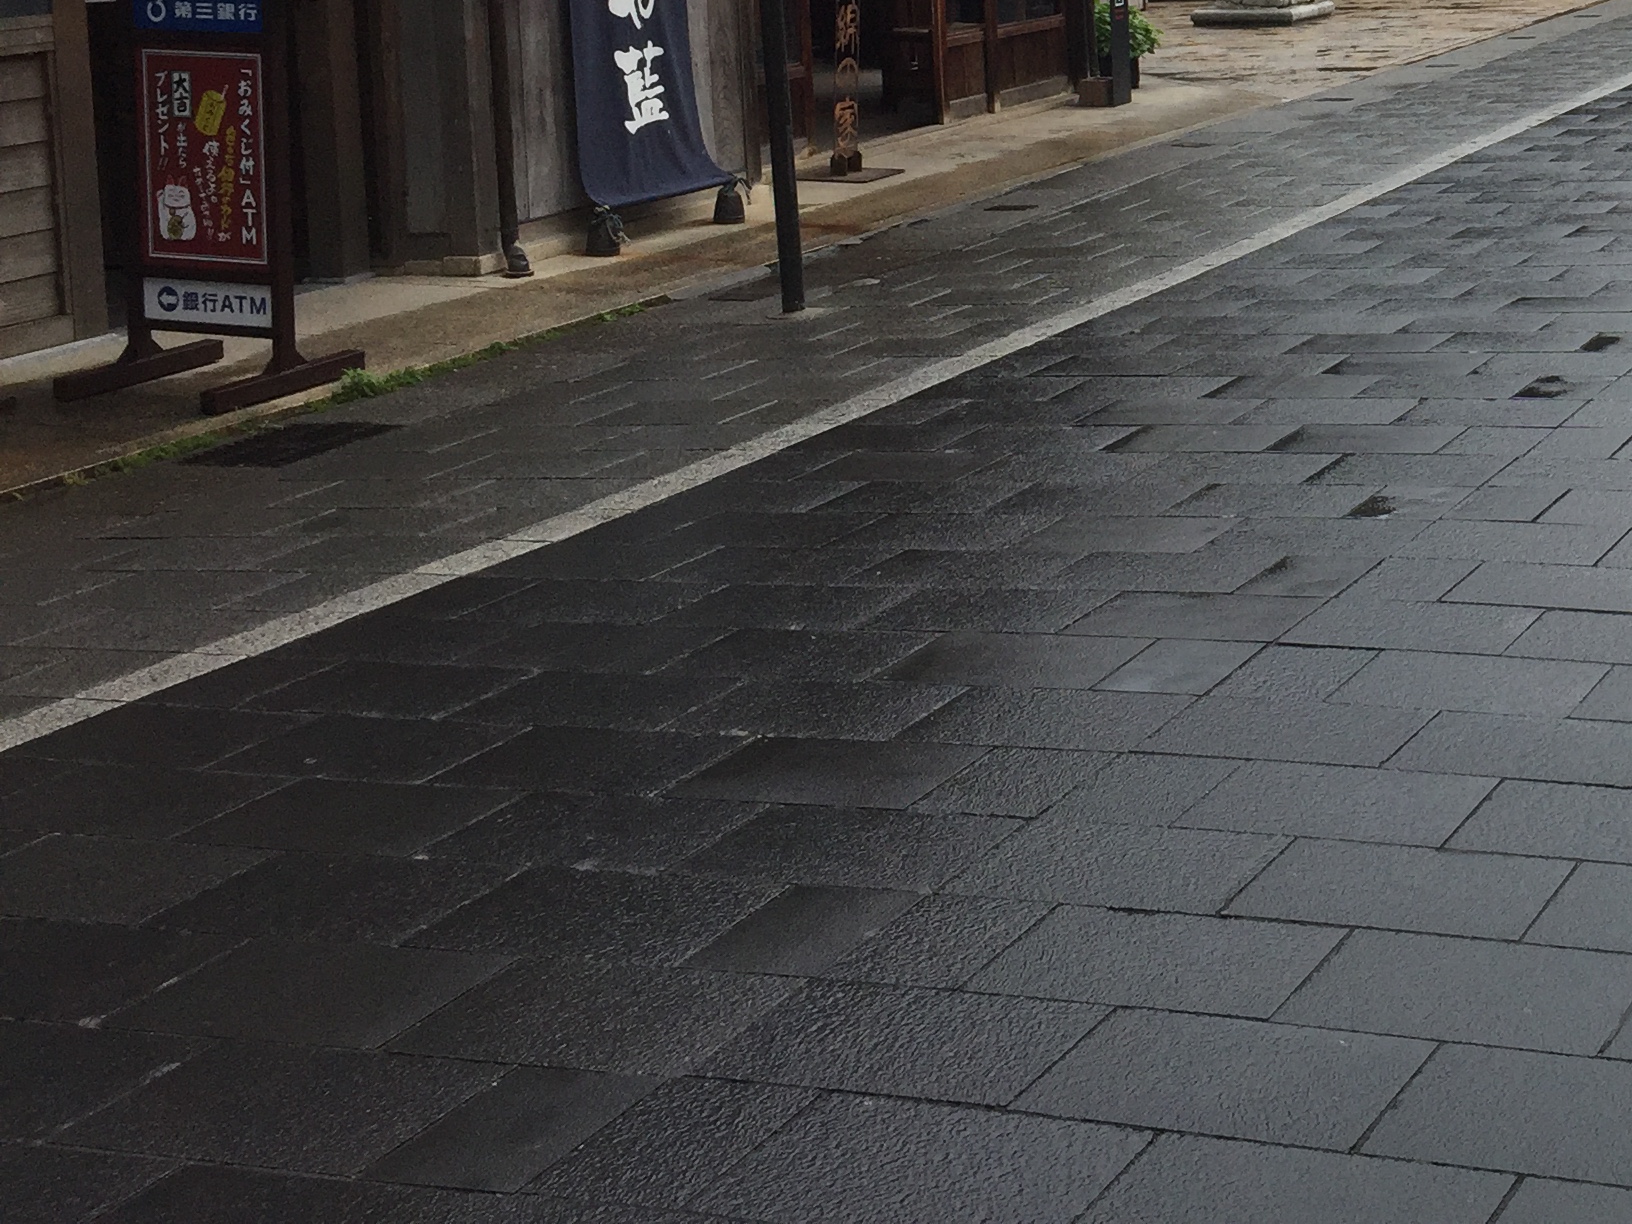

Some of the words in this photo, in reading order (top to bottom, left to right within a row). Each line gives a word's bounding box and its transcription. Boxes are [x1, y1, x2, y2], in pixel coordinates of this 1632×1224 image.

[174, 0, 258, 21] 第三銀行
[182, 291, 267, 315] 銀行ATM
